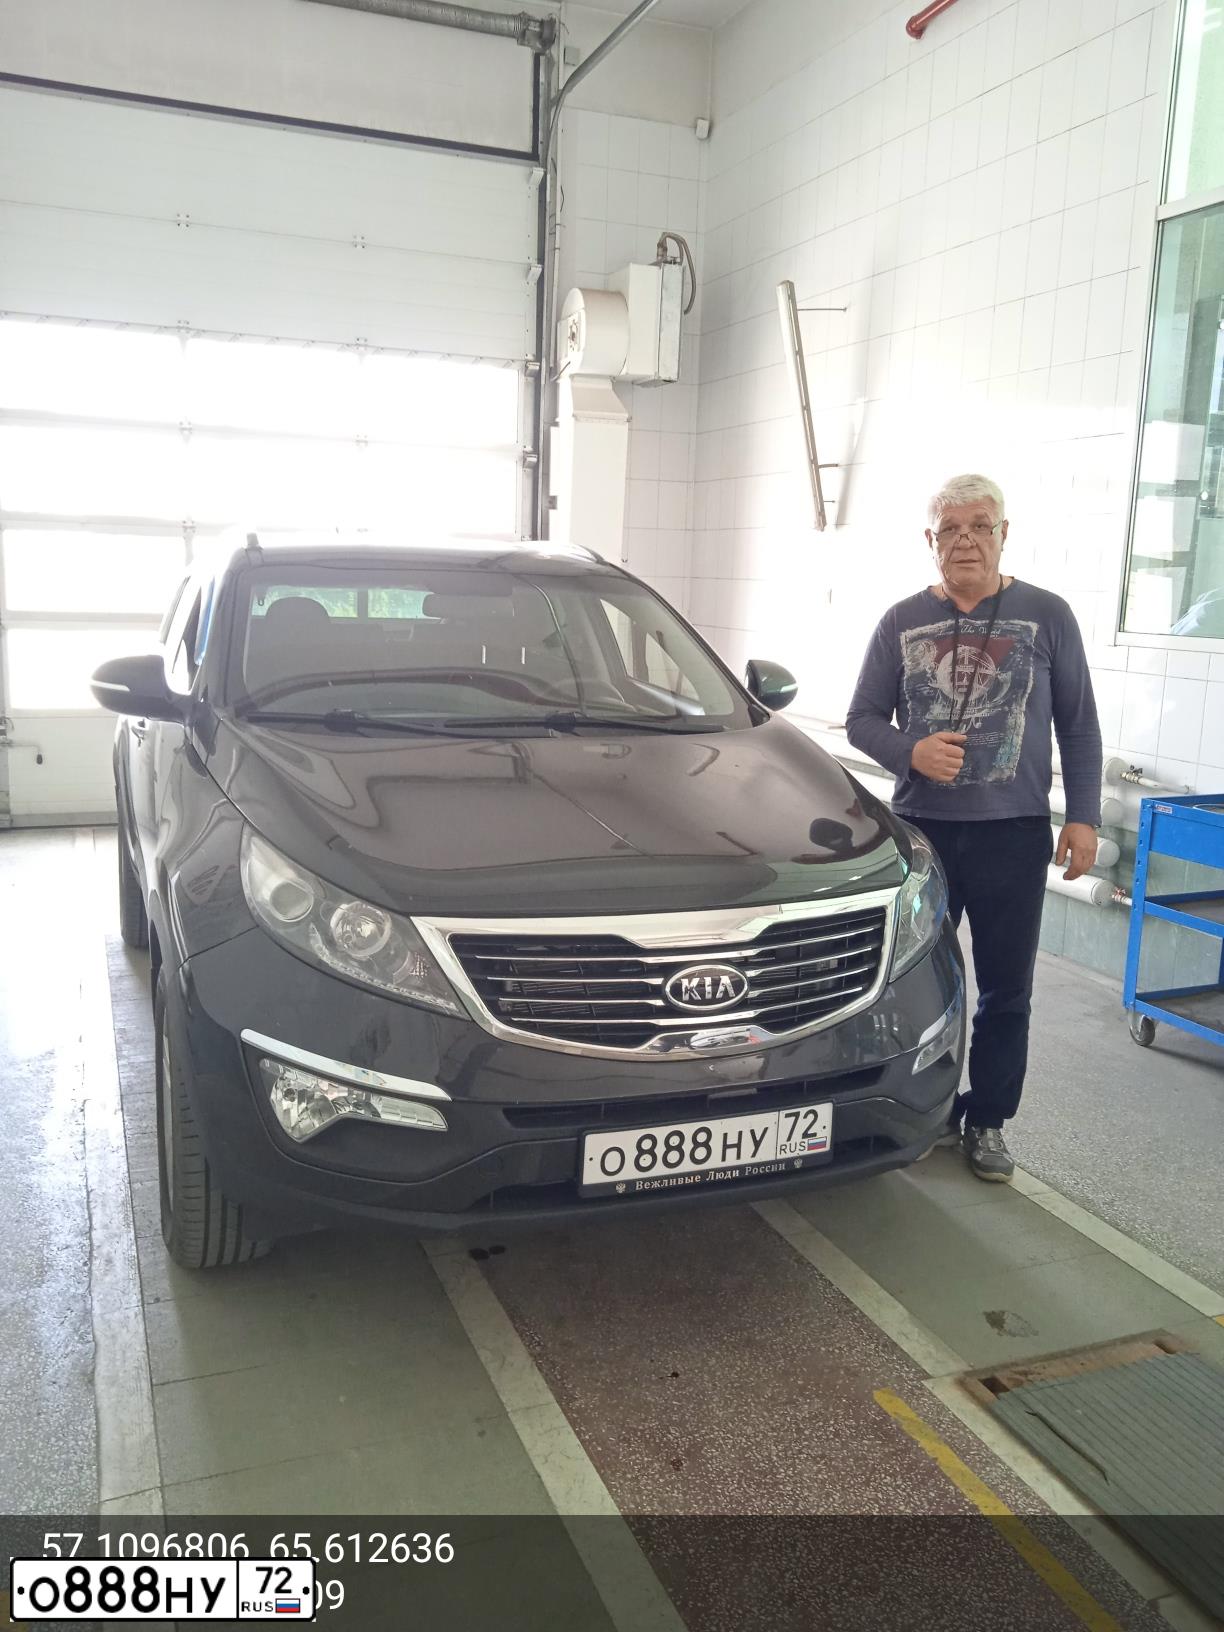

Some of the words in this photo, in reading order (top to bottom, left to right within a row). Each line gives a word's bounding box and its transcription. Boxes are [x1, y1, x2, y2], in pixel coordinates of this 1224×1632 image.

[681, 975, 736, 1001] KIA
[784, 1108, 819, 1142] 72
[779, 1141, 806, 1156] RUS
[635, 1174, 702, 1191] Вежливые
[706, 1168, 739, 1181] Люди
[744, 1162, 786, 1176] России
